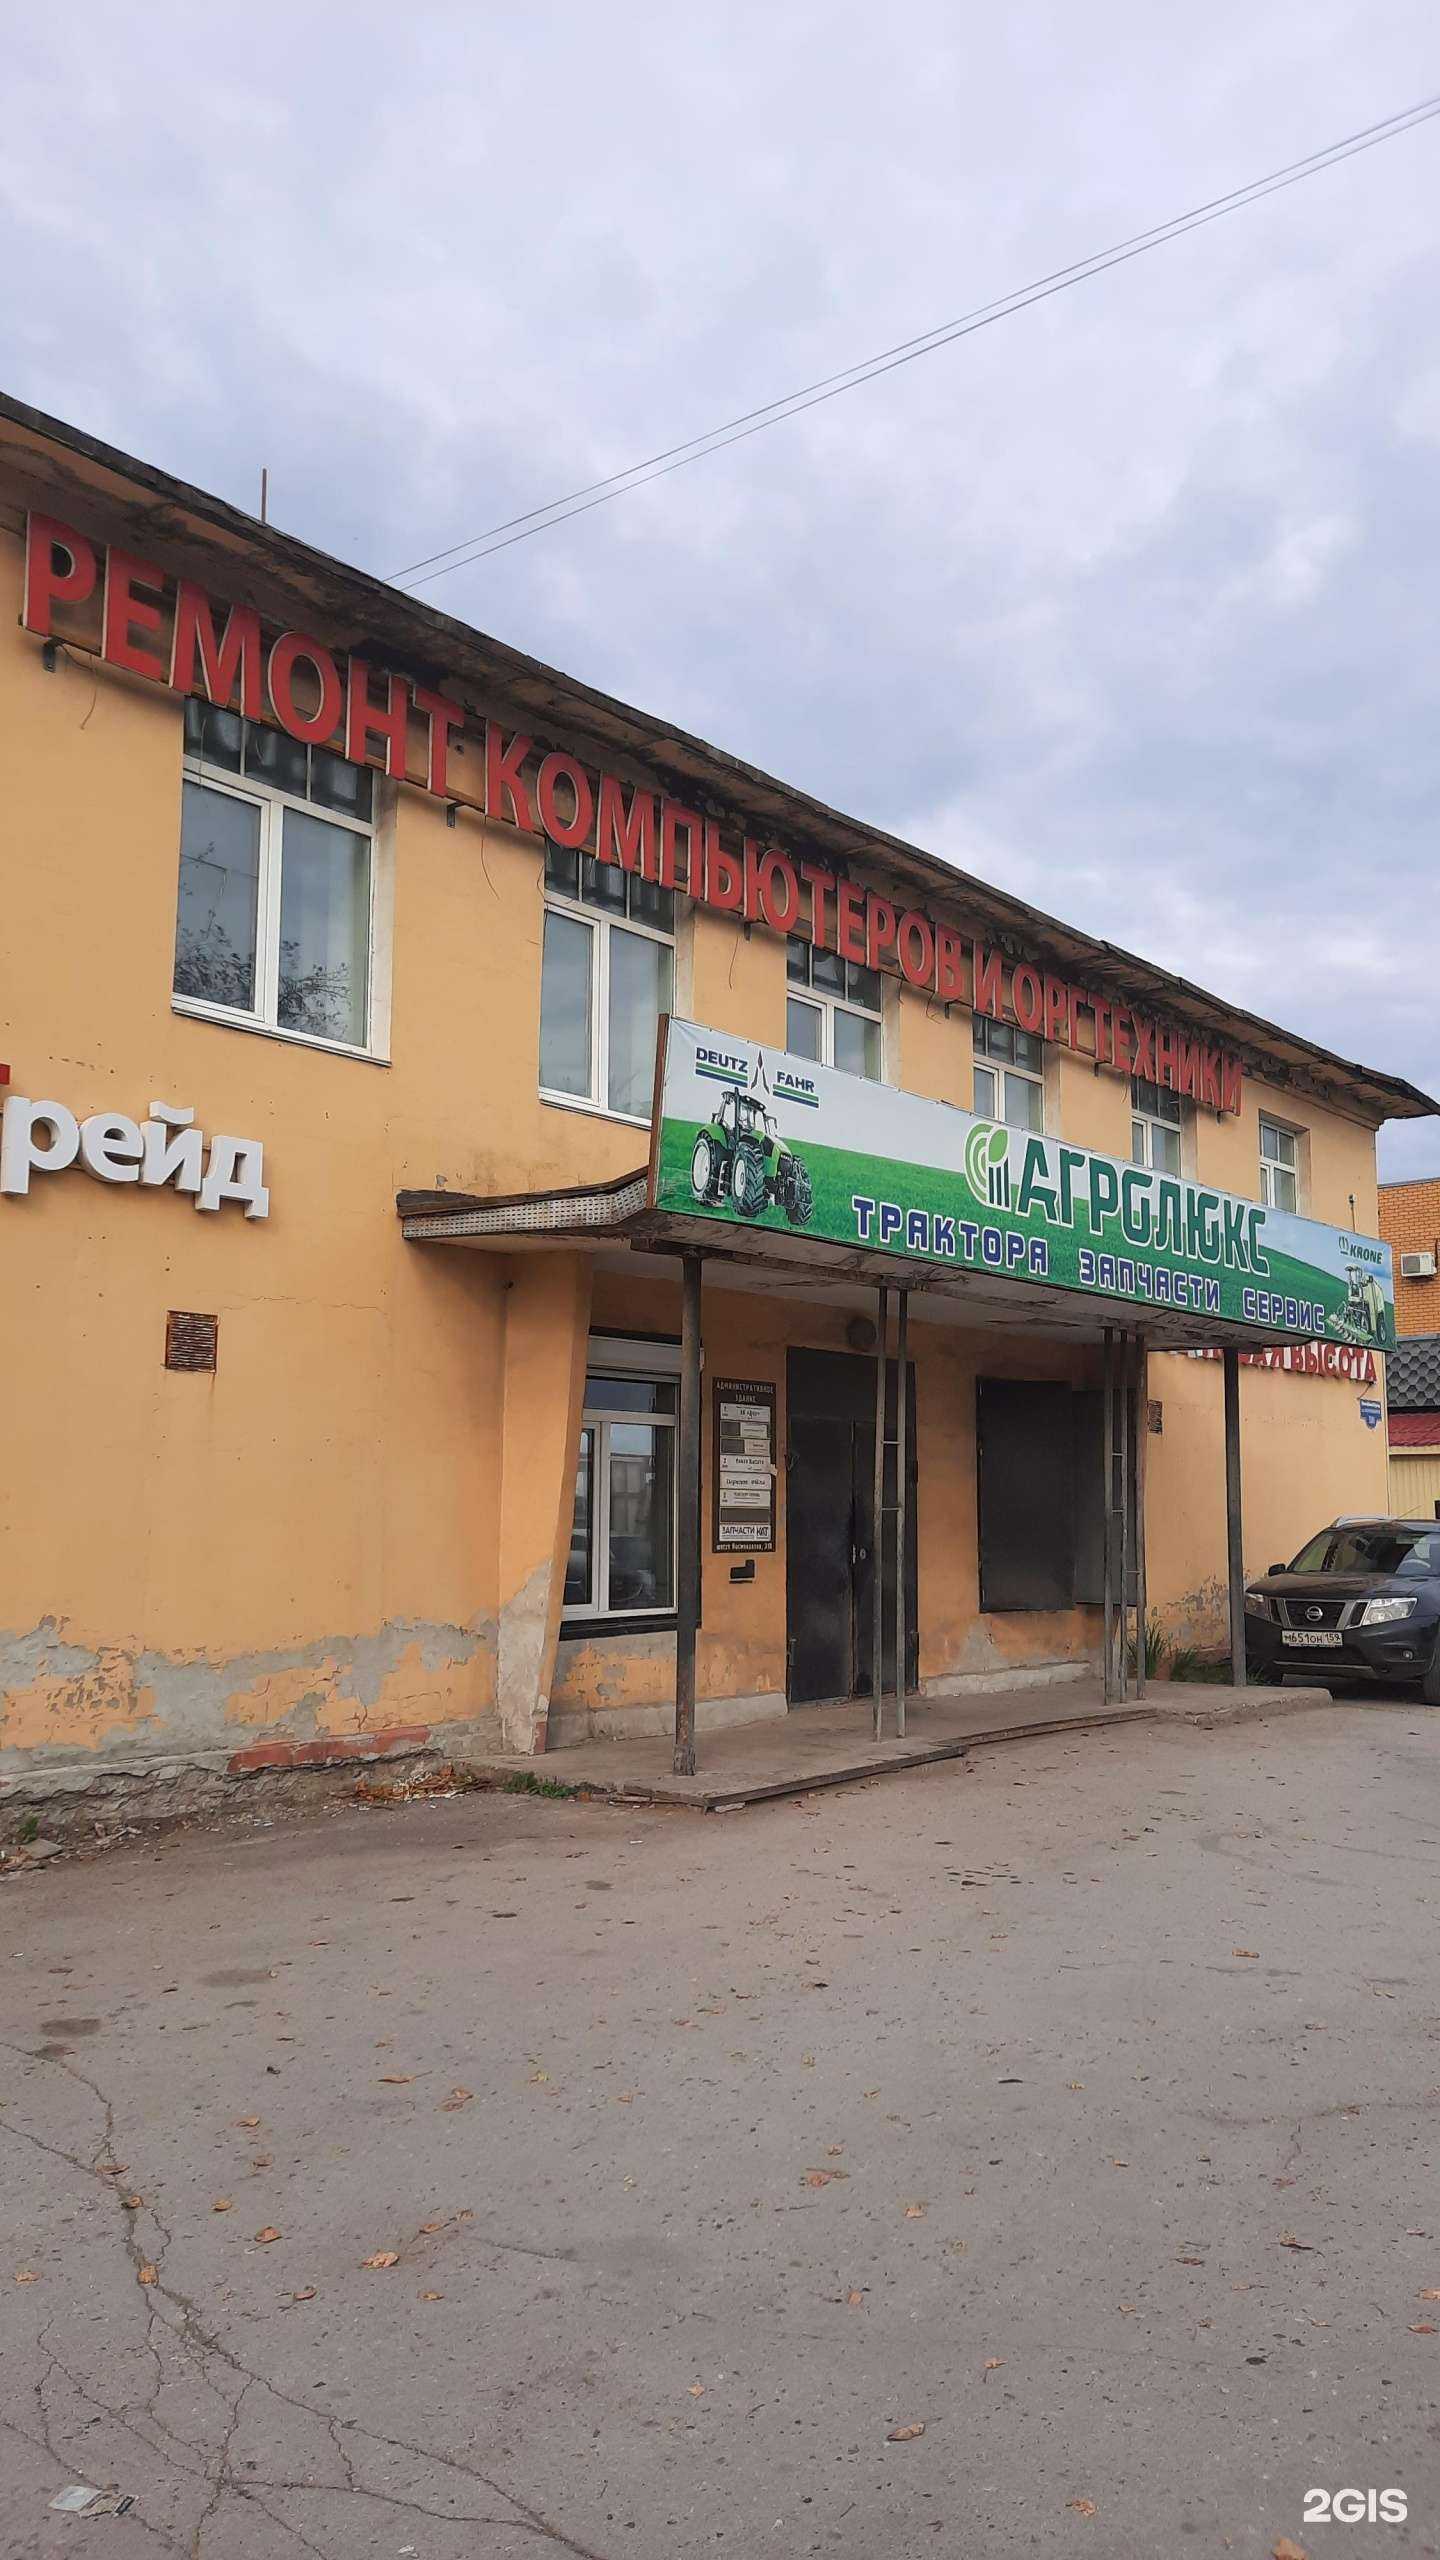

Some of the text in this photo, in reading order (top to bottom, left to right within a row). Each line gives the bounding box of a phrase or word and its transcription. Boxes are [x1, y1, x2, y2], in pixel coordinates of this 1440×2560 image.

[23, 510, 1244, 1118] РЕМОНТ КОМПЬЮТЕРОВ И ОРГТЕХНИКИ
[695, 1046, 815, 1094] DEUTZ FAHR
[1015, 1136, 1271, 1278] АГРОЛЮКС
[851, 1194, 1326, 1334] ТРАКТОРА ЗАПЧАСТИ СЕРВИС
[1349, 1243, 1384, 1265] KRONE
[1291, 1343, 1377, 1382] ВЫСОТА
[721, 1526, 755, 1536] ЗАПЧАСТИ
